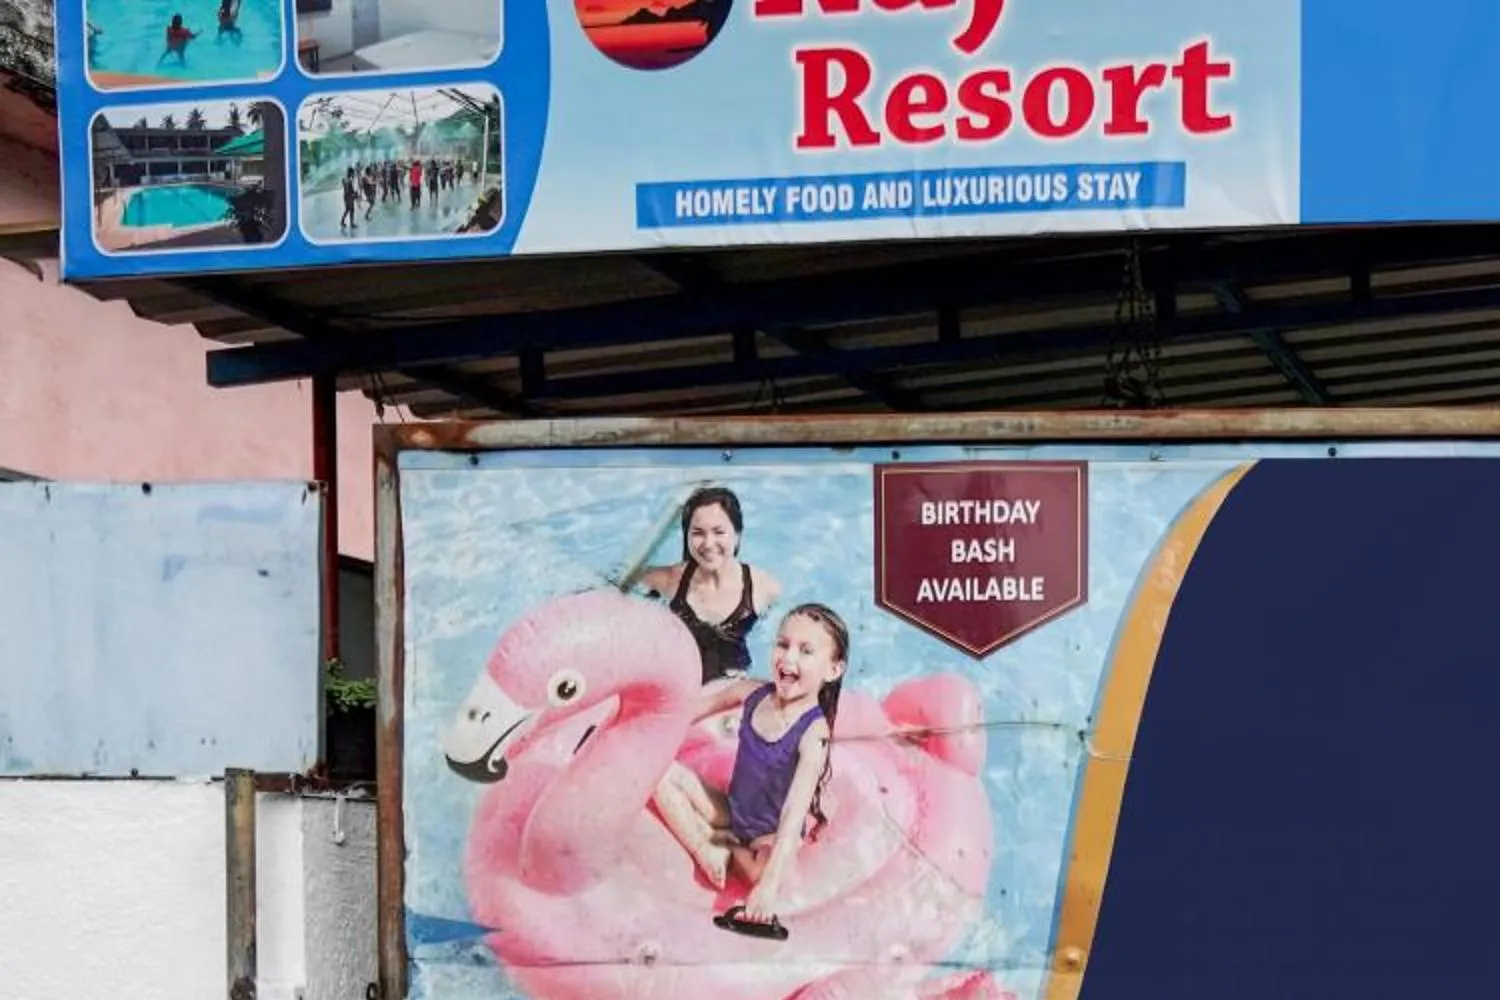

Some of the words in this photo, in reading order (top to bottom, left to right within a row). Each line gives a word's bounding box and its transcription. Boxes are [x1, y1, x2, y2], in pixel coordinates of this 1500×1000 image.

[796, 42, 1231, 150] Resort
[674, 187, 777, 219] HOMELY
[786, 183, 854, 213] FOOD
[862, 180, 913, 210] AND
[922, 173, 1068, 208] LUXURIOUS
[1077, 171, 1142, 201] STAY
[921, 501, 1040, 525] BIRTHDAY
[951, 539, 1015, 563] BASH
[917, 577, 1044, 602] AVAILABLE
